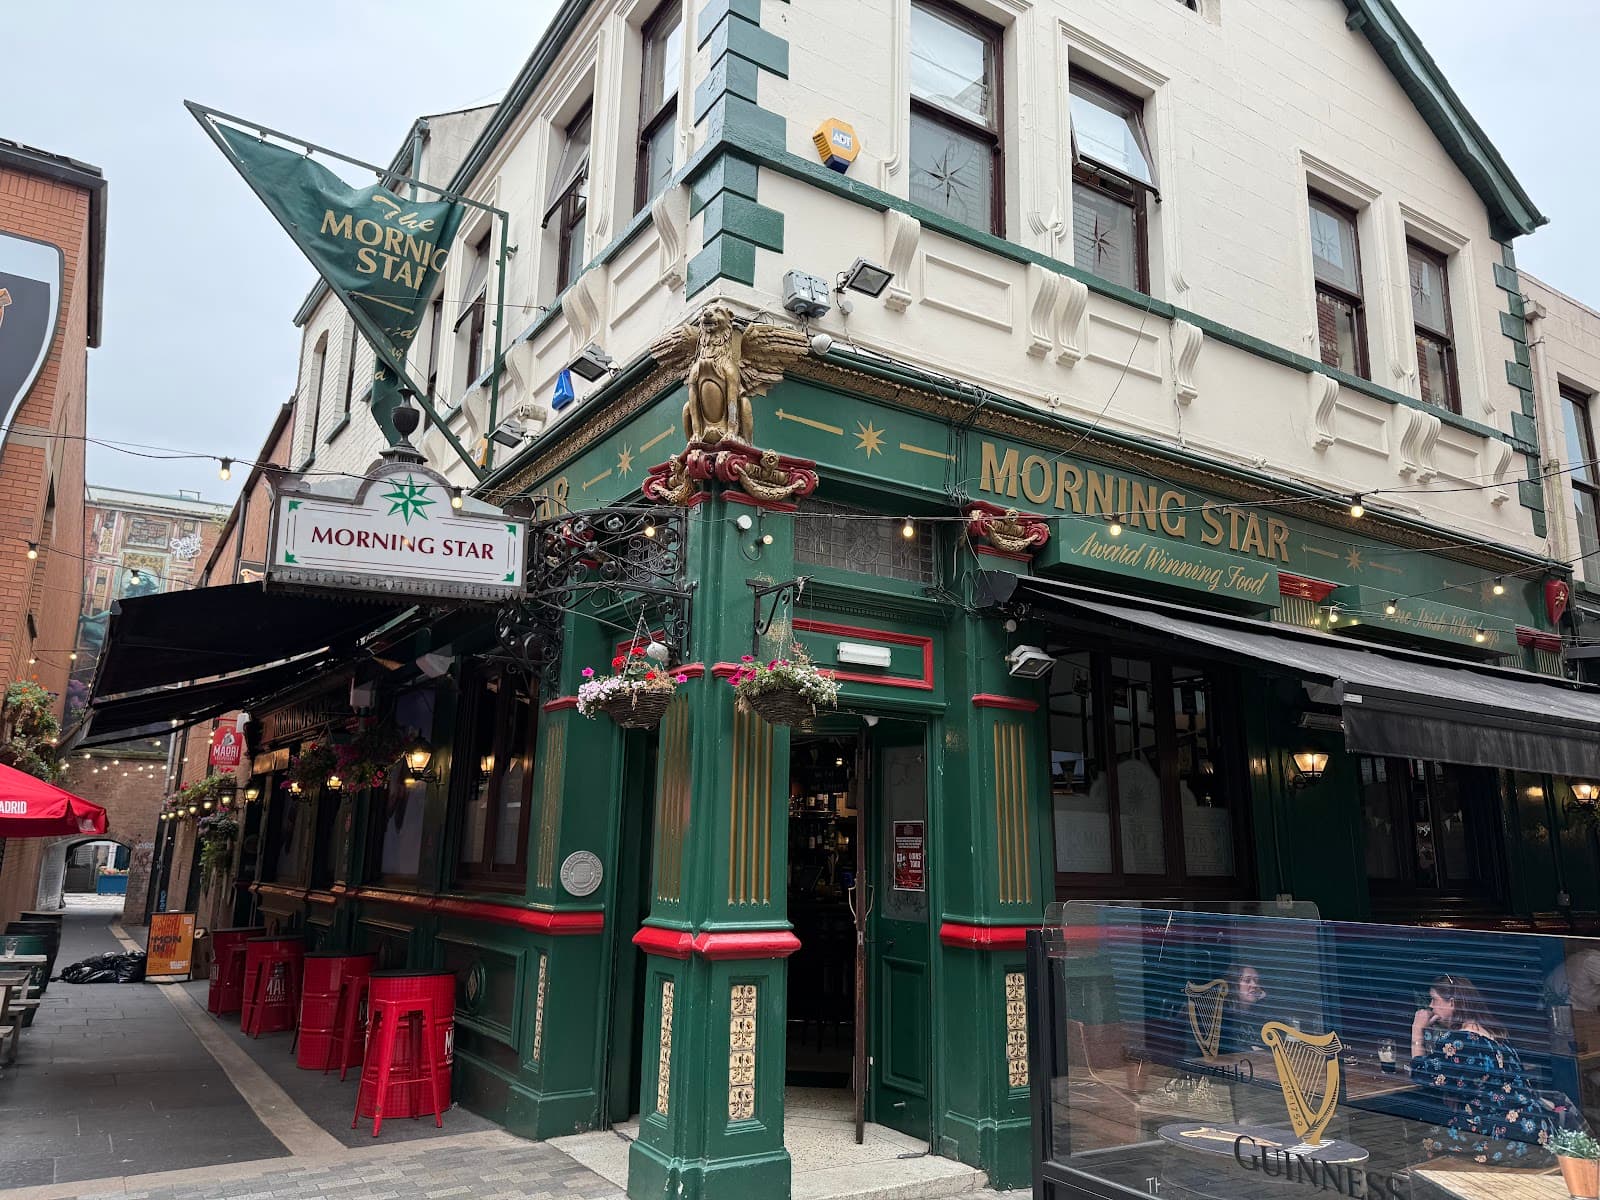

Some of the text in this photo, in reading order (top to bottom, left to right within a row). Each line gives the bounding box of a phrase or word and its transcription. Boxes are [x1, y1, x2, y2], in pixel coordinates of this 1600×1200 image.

[372, 195, 435, 232] The
[979, 441, 1290, 563] MORNING STAR
[311, 526, 494, 560] MORNING STAR
[1071, 531, 1270, 596] Award Winning Food
